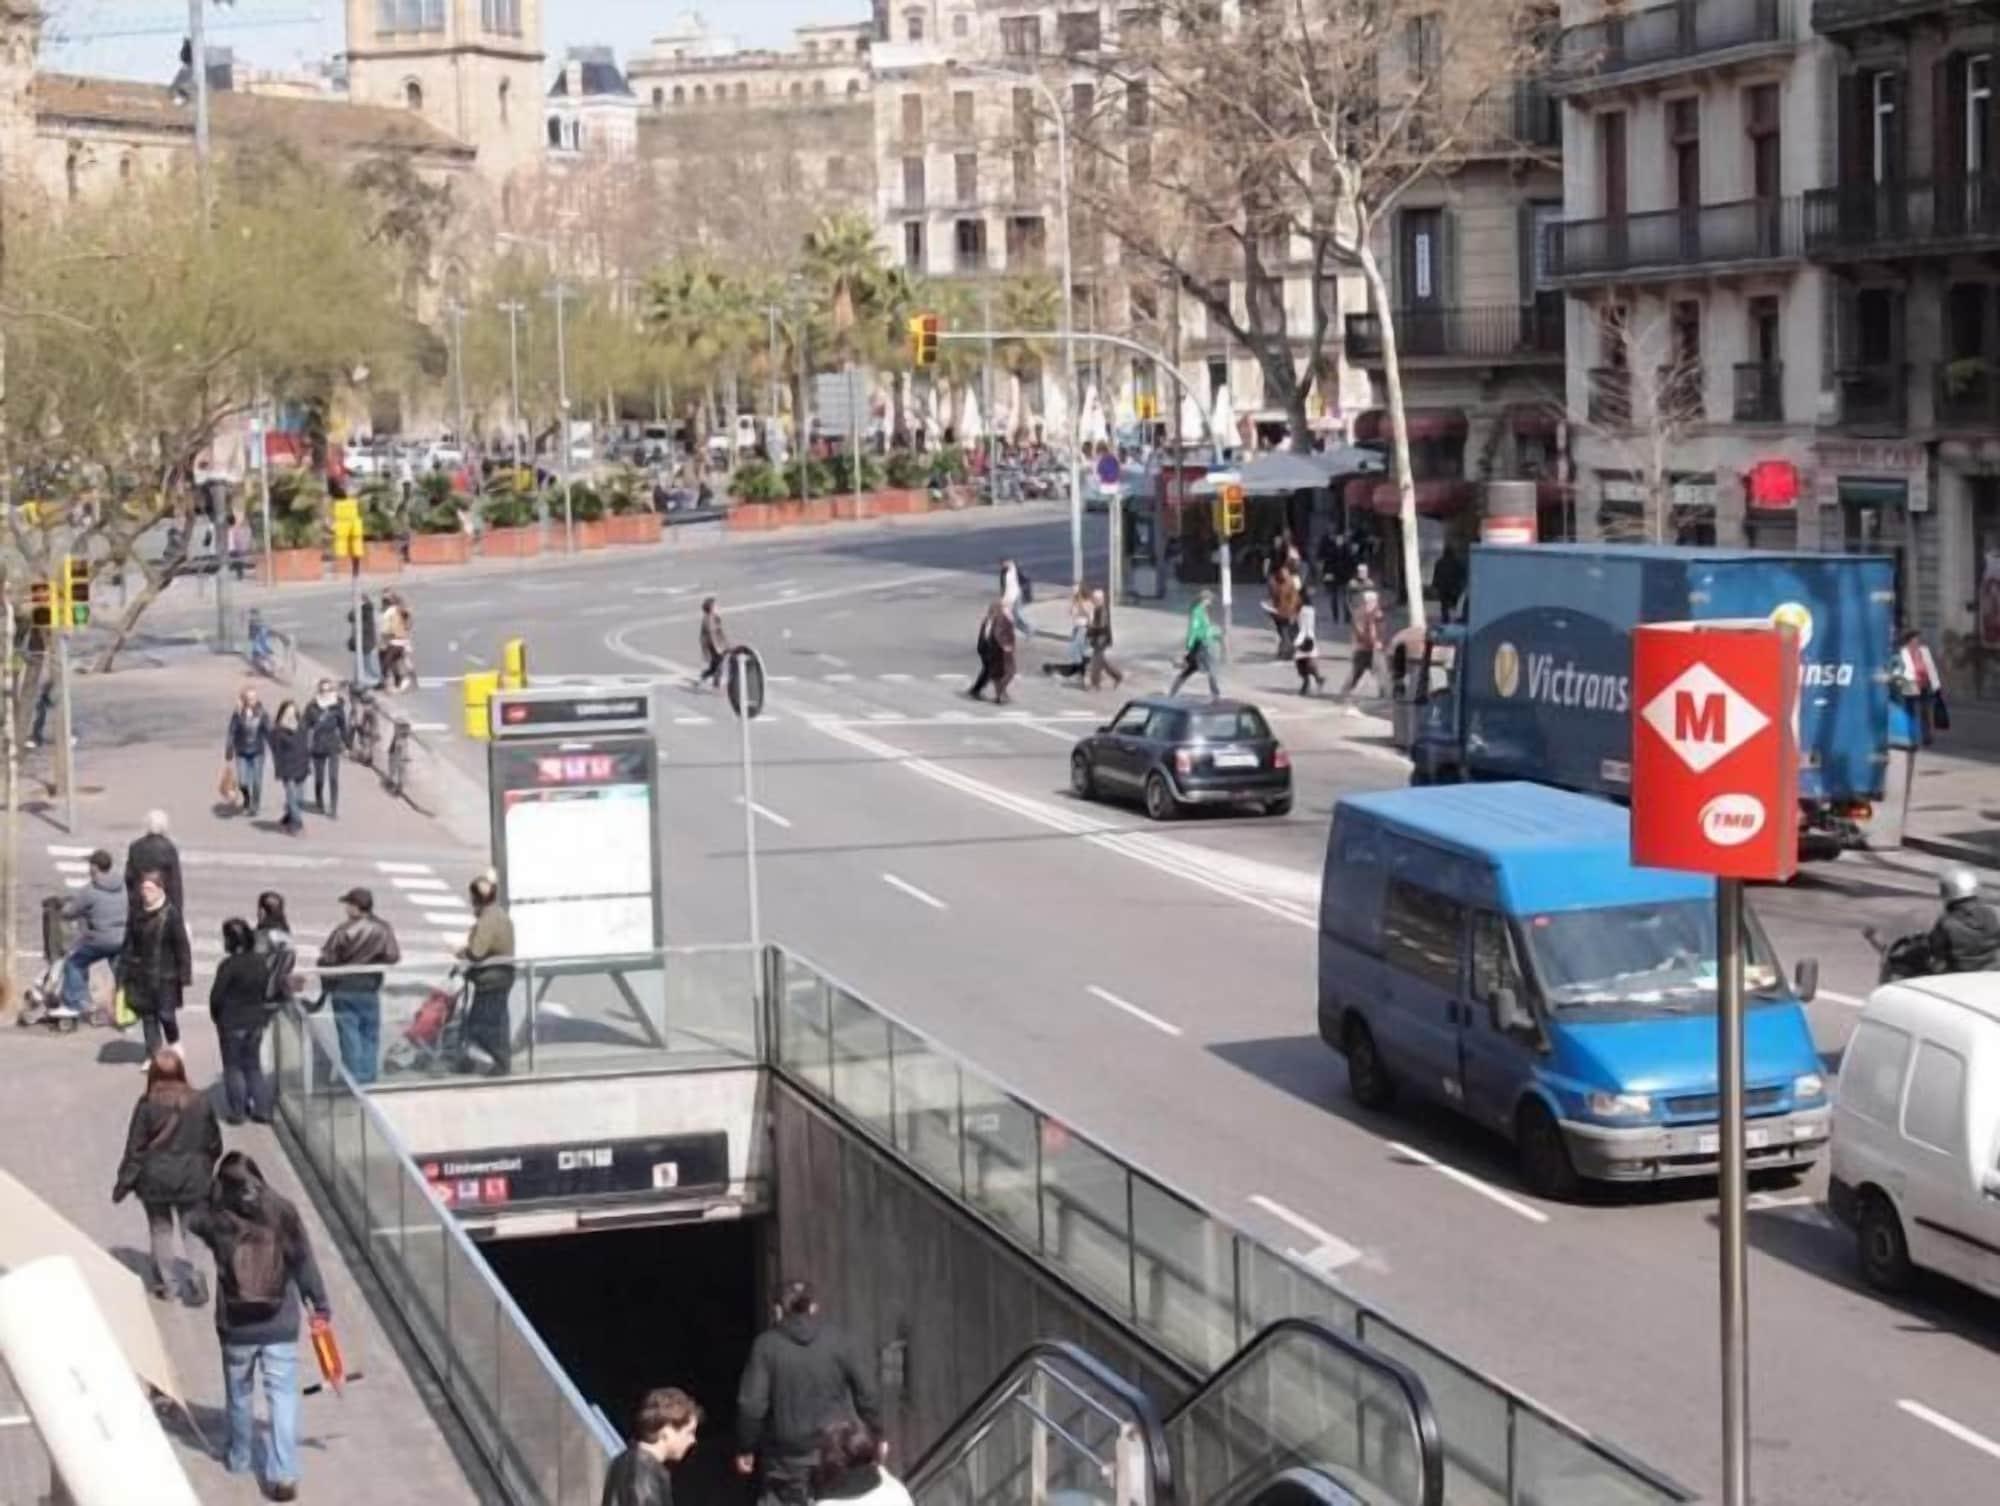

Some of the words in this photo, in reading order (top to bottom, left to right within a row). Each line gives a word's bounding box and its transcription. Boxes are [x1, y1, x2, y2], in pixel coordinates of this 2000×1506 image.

[1527, 651, 1630, 713] Victrans
[1675, 690, 1727, 744] M
[1711, 812, 1757, 830] TMB
